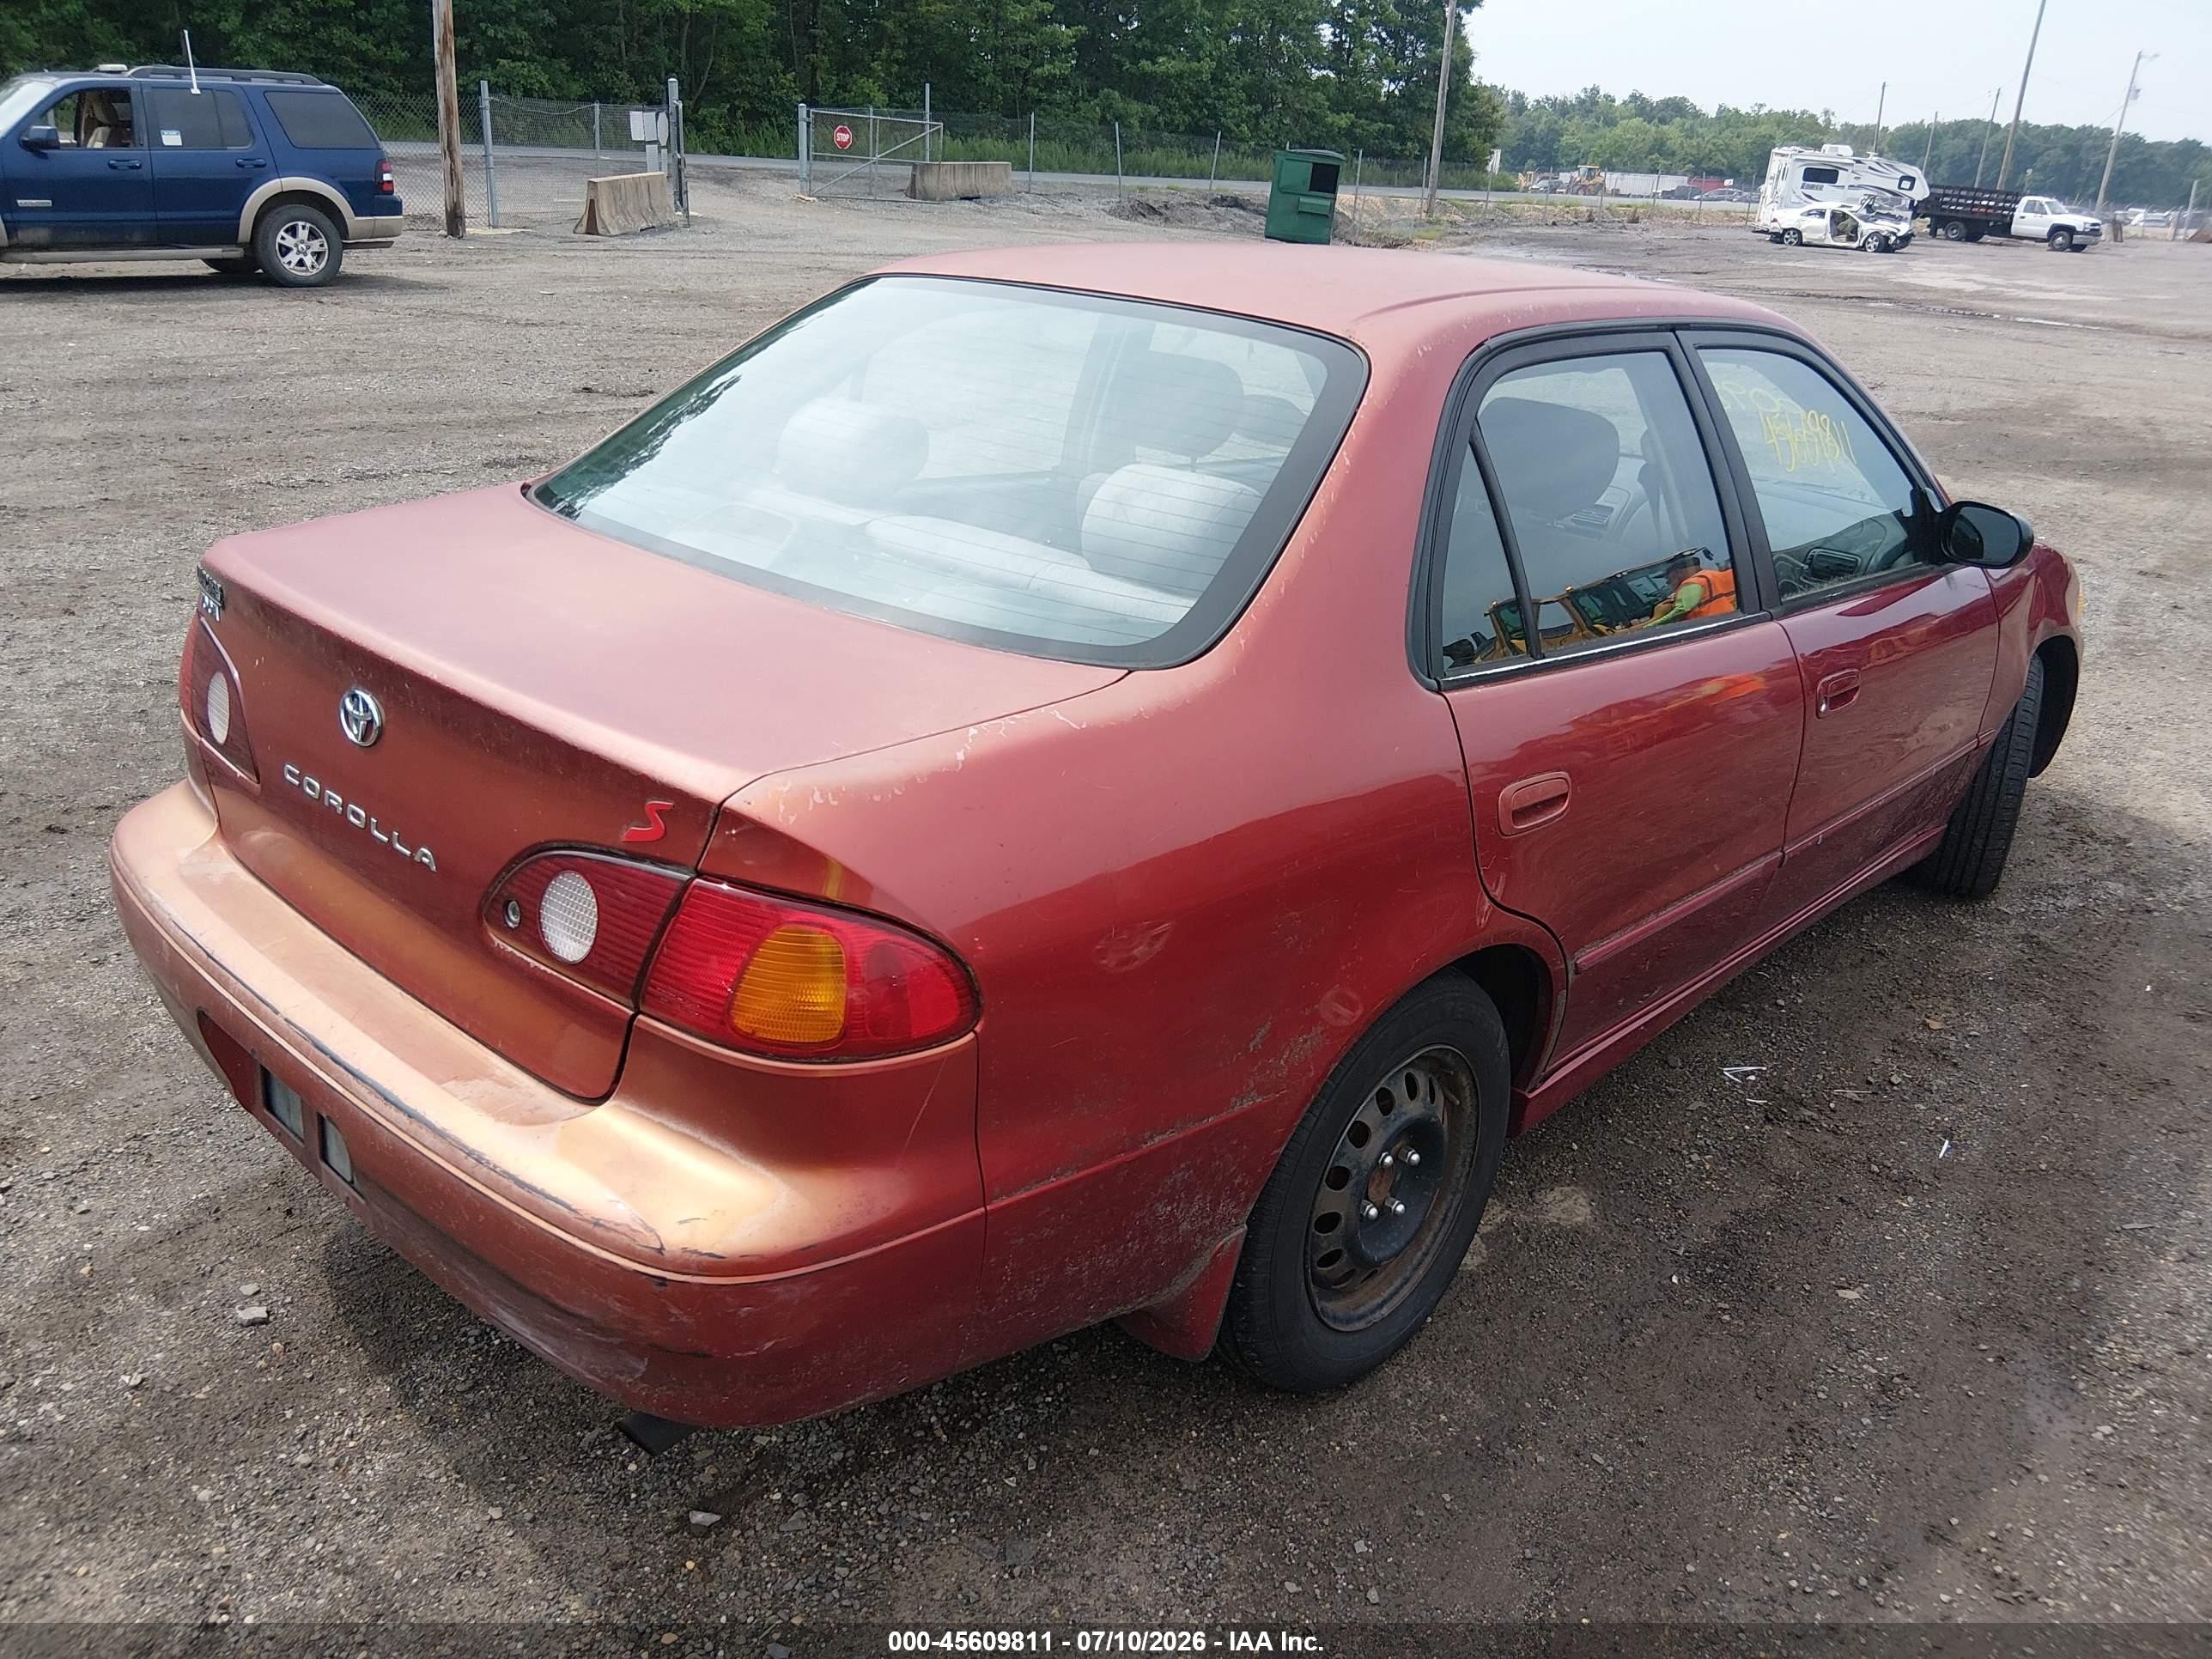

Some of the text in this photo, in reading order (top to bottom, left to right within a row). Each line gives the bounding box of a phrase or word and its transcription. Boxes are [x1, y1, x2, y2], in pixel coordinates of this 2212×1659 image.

[836, 132, 850, 143] STOP
[283, 763, 437, 872] COROLLA
[622, 799, 674, 842] S
